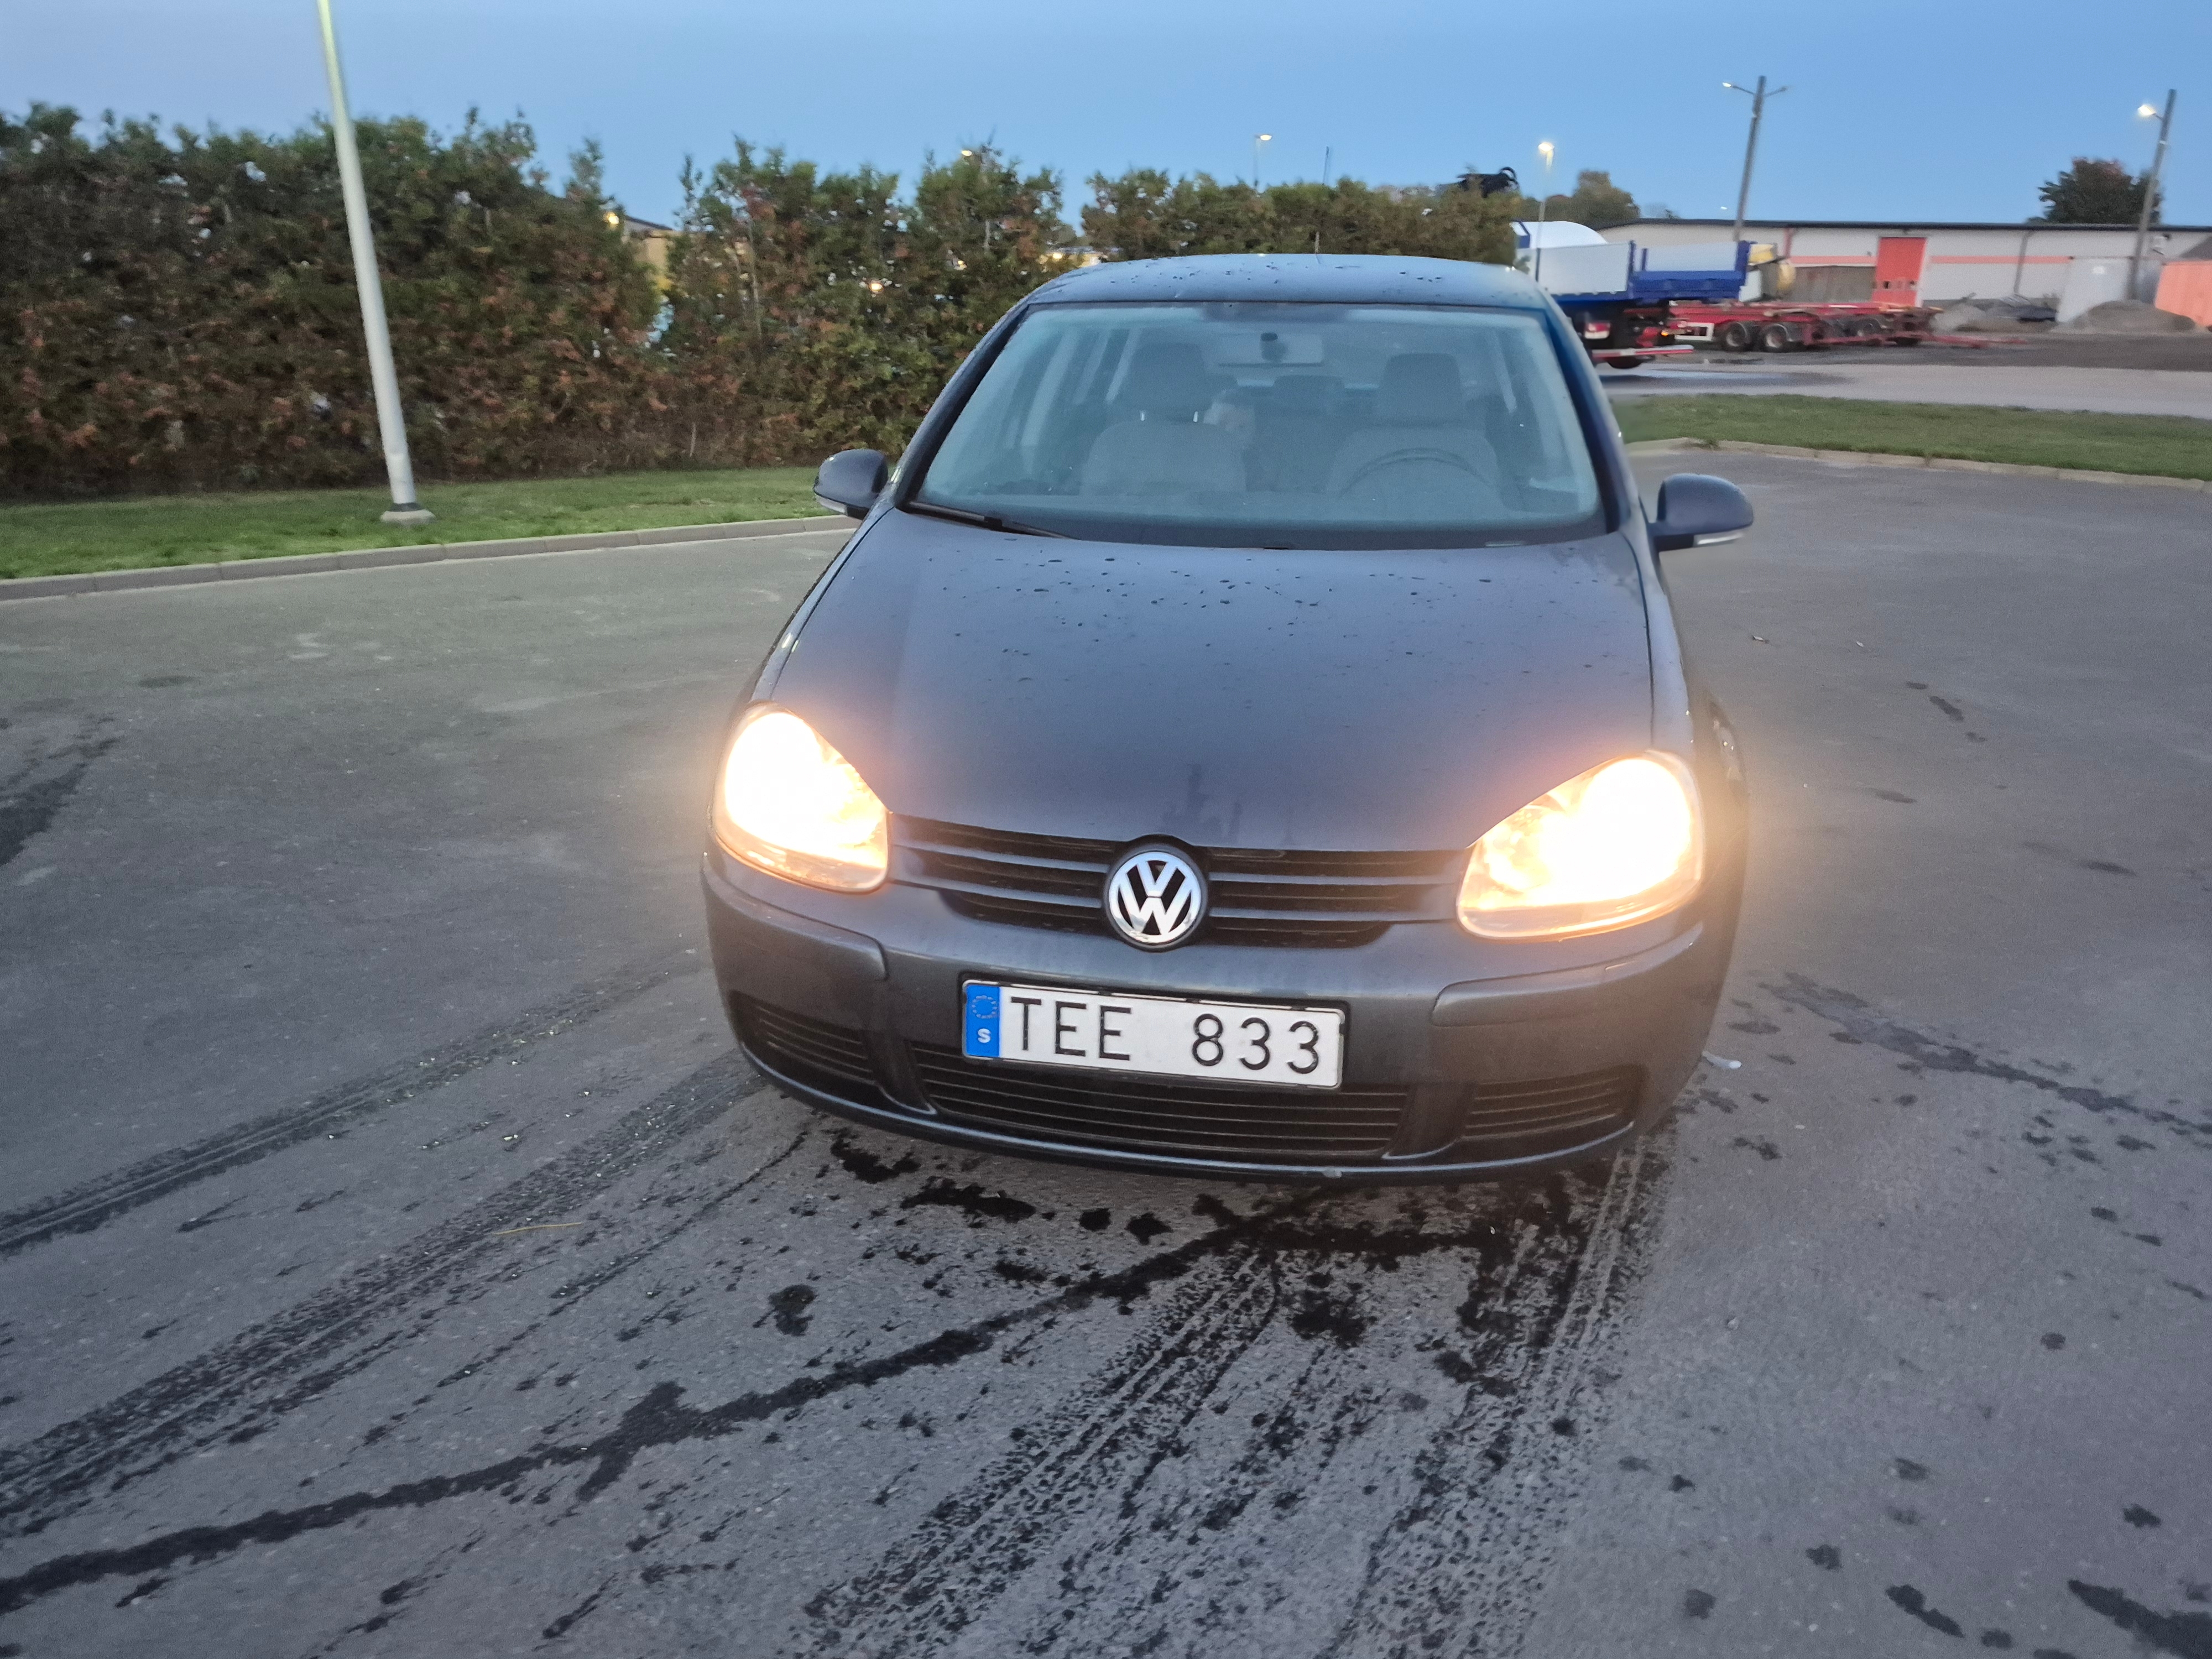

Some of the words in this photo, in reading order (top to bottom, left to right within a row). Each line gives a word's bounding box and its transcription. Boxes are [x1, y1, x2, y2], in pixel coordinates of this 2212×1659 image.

[1113, 856, 1196, 938] VW
[978, 1028, 992, 1044] S
[1010, 997, 1132, 1061] TEE
[1192, 1013, 1320, 1074] 833
